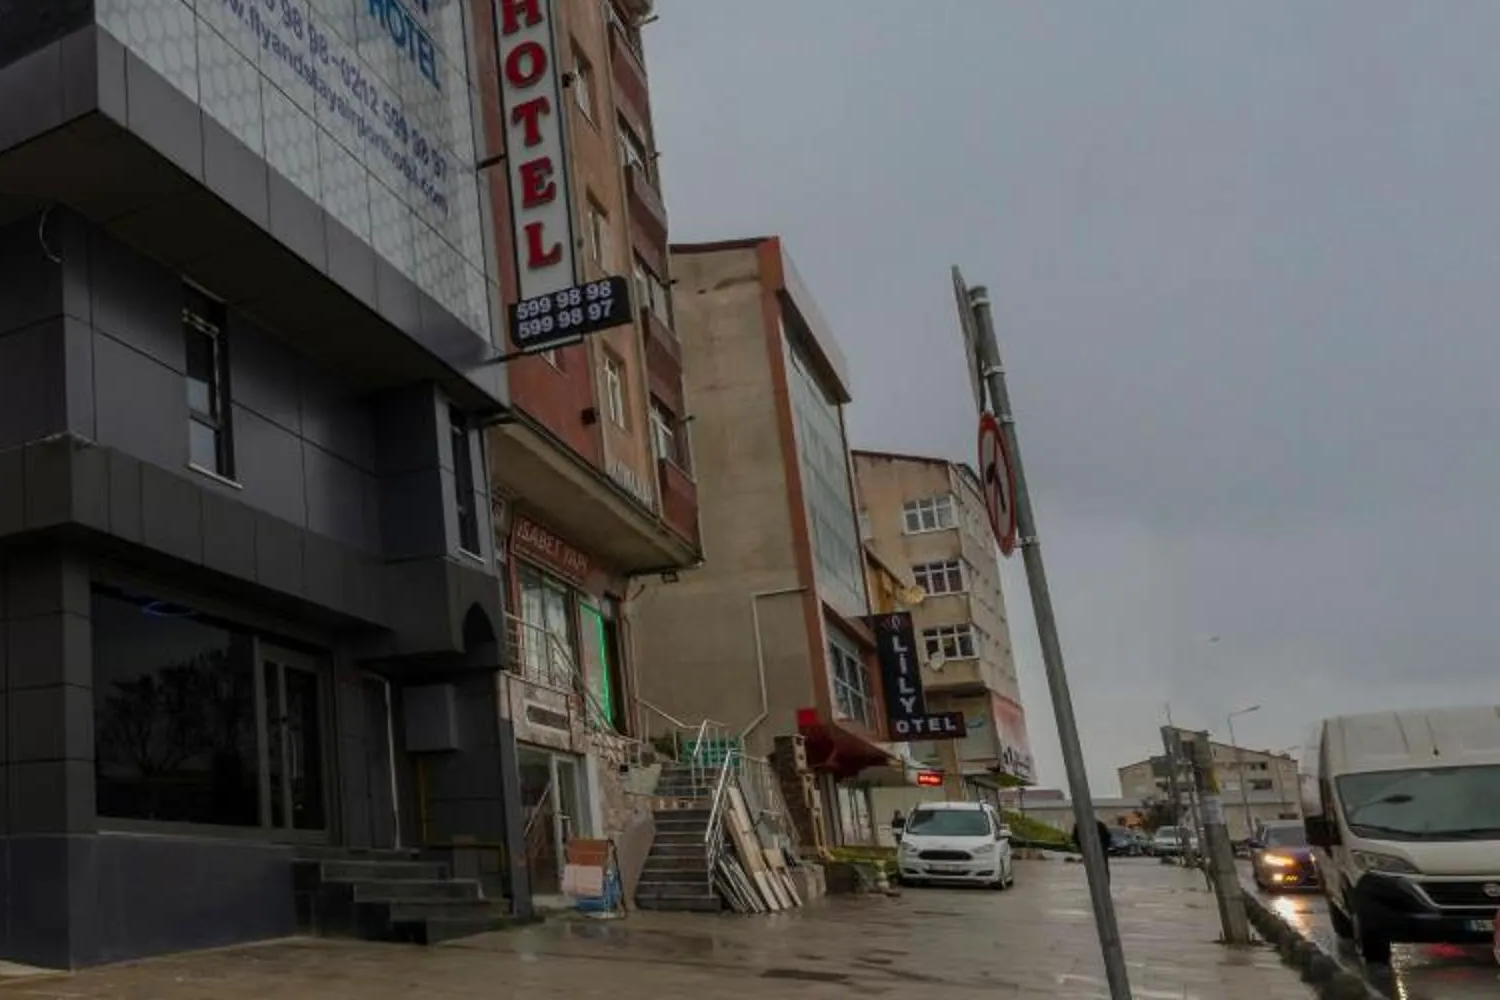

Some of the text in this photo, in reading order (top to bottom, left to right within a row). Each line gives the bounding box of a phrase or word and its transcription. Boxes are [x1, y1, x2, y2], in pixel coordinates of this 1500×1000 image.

[516, 281, 612, 320] 599 98 98
[519, 299, 613, 338] 599 98 97
[896, 717, 957, 733] OTEL
